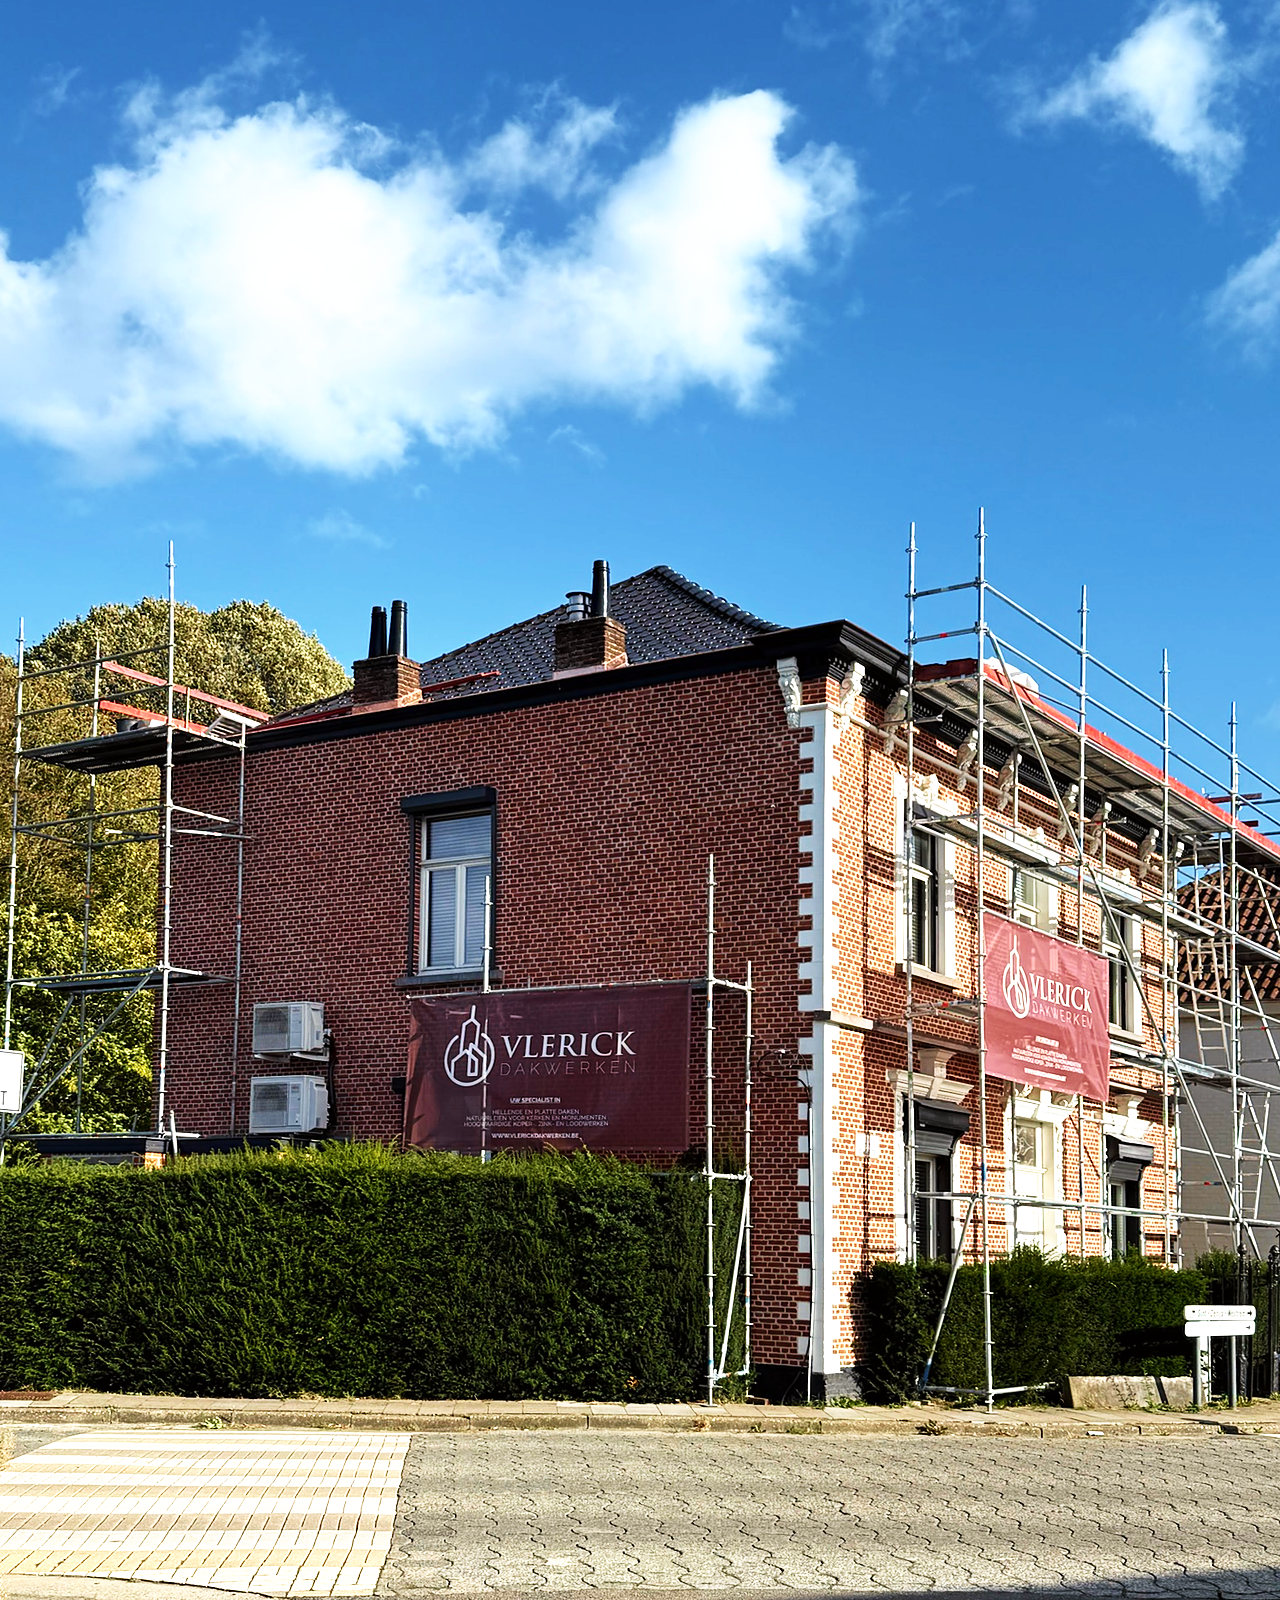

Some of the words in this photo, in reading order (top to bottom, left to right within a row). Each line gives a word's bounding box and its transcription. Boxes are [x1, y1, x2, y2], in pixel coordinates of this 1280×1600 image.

[1029, 972, 1092, 1013] VLERICK
[1032, 1000, 1093, 1030] DAKWERKEN
[500, 1031, 637, 1059] VLERICK
[500, 1060, 636, 1076] DAKWERKEN
